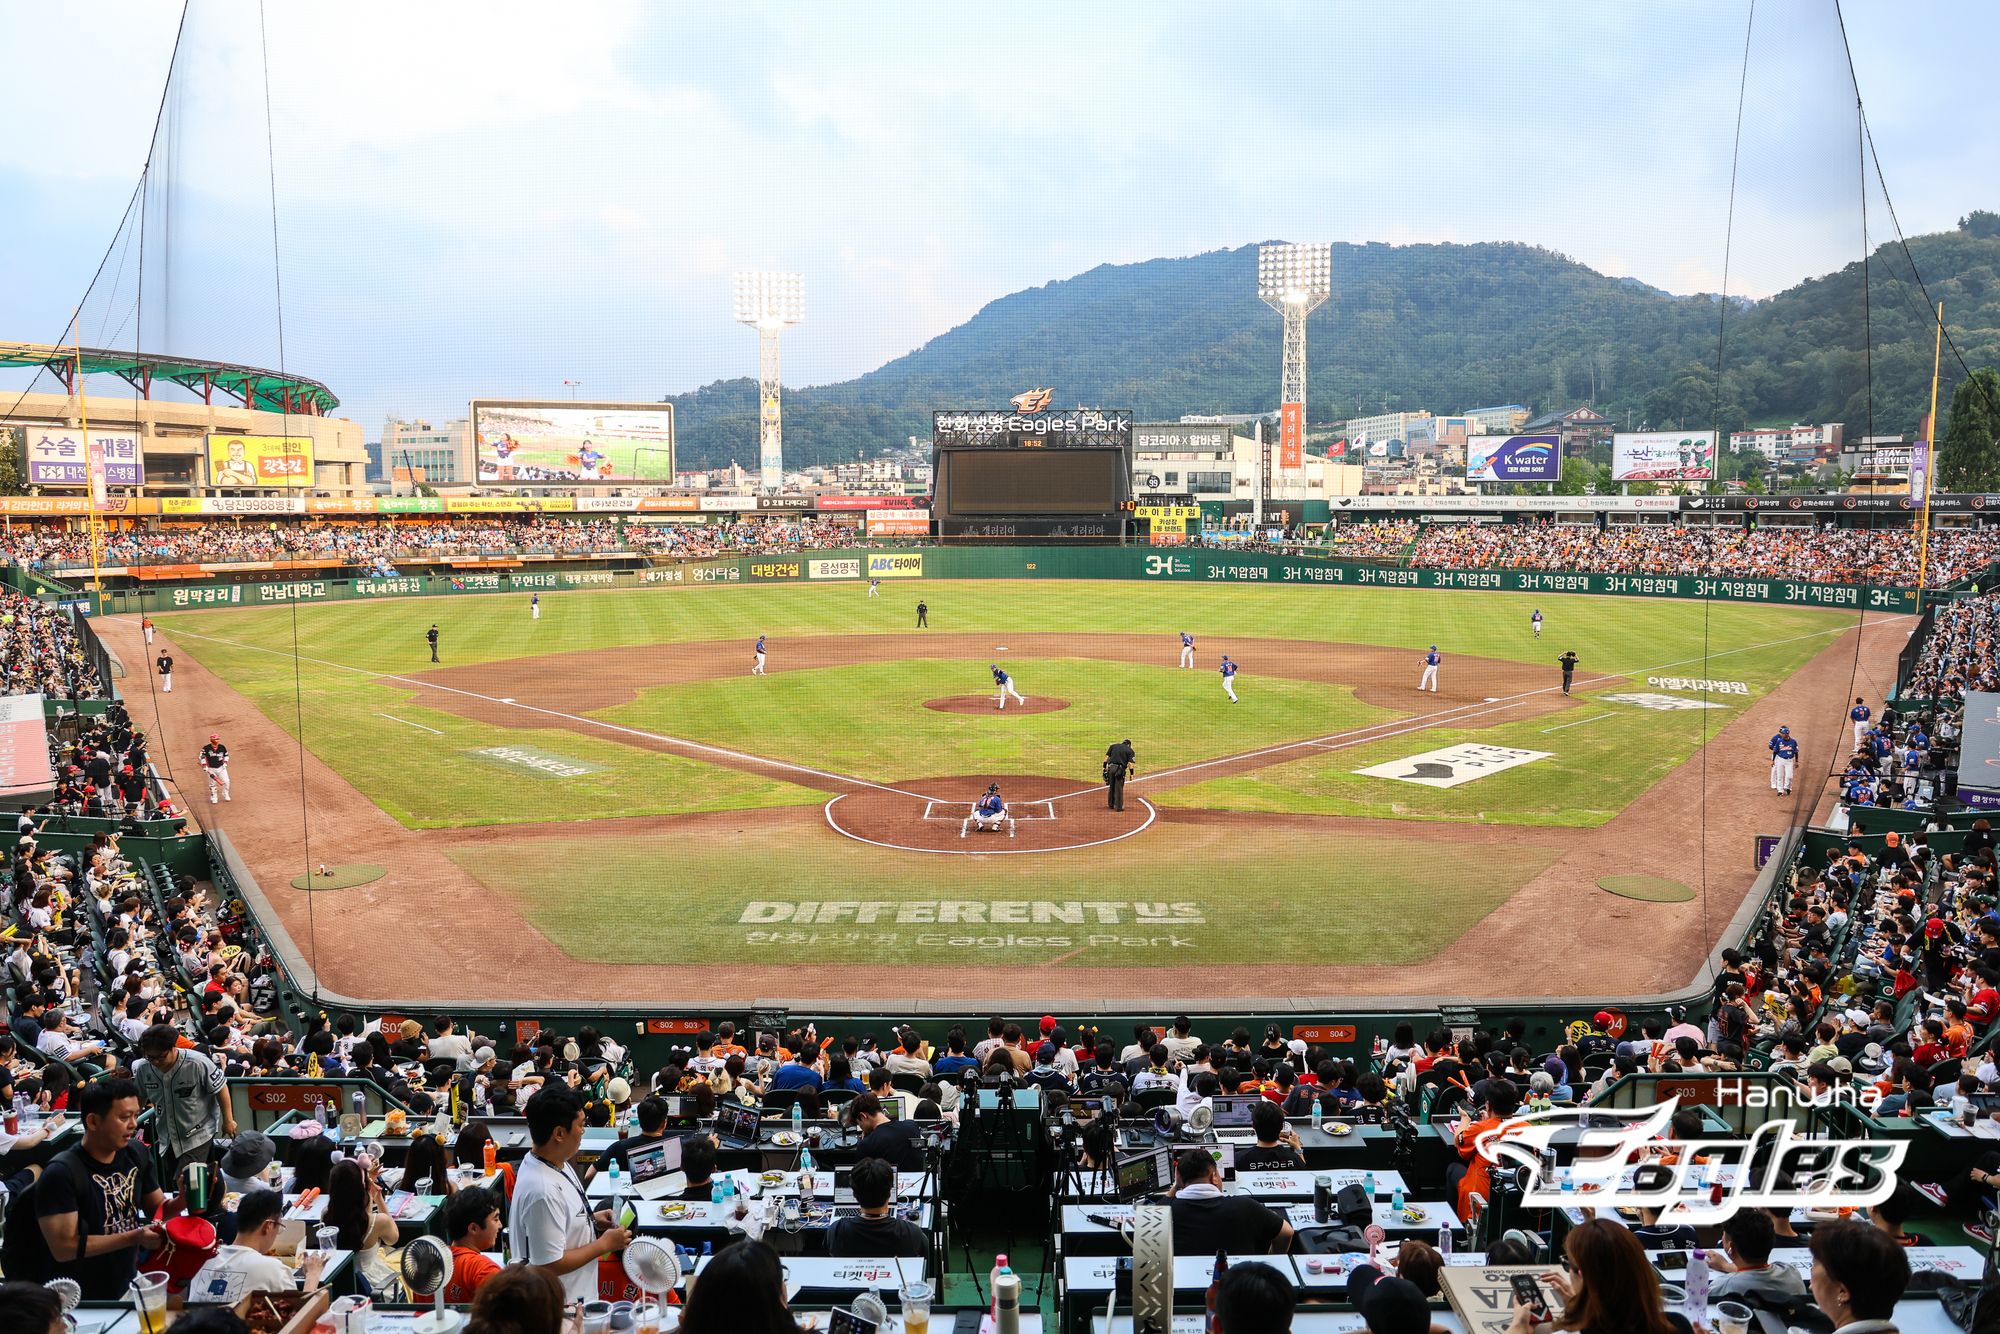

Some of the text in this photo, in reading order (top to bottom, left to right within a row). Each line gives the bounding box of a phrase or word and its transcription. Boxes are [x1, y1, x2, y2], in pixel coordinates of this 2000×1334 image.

[937, 415, 1129, 435] 한화생명 Eagles Park
[1138, 434, 1180, 446] 잡코리아
[1189, 434, 1222, 446] 알바몬
[1287, 410, 1296, 462] 갤러리아
[36, 436, 77, 457] 수술
[1878, 449, 1901, 457] STAY
[1504, 454, 1549, 465] K water
[1863, 457, 1914, 465] INTERVIEW
[66, 465, 137, 480] 대전스병원
[1148, 479, 1159, 488] 99
[224, 499, 296, 511] 당진9988병원
[981, 524, 1016, 536] 갤러리아
[1070, 524, 1105, 536] 갤러리아
[646, 570, 683, 583] 예가정성
[751, 563, 800, 578] 대방건설
[820, 562, 859, 576] 음성명작
[1207, 565, 1268, 580] 3H 지압침대
[1283, 566, 1343, 581] 3H 지압침대
[1358, 568, 1418, 585] 3H 지압침대
[1433, 571, 1501, 587] 3H 지압침대
[1518, 574, 1589, 591] 3H 지압침대
[1604, 576, 1678, 594] 3H 지압침대
[260, 582, 326, 601] 한남대학교
[355, 581, 421, 595] 백제세계유산
[1694, 579, 1769, 599] 3H 지압침대
[1784, 583, 1857, 604] 3H 지압침대
[1904, 591, 1916, 600] 100
[173, 588, 229, 606] 원막걸리
[1647, 676, 1750, 695] 이엘치과병원
[1464, 750, 1532, 768] PLUS
[738, 900, 1129, 924] DIFFERENT
[915, 933, 1072, 948] Eagles
[1087, 933, 1198, 948] Park
[660, 1021, 698, 1029] S02 S03
[1305, 1030, 1344, 1038] S03 S04
[265, 1092, 324, 1104] S02 S03
[1249, 1160, 1295, 1170] SPYDER
[833, 1268, 892, 1282] 티켓링크
